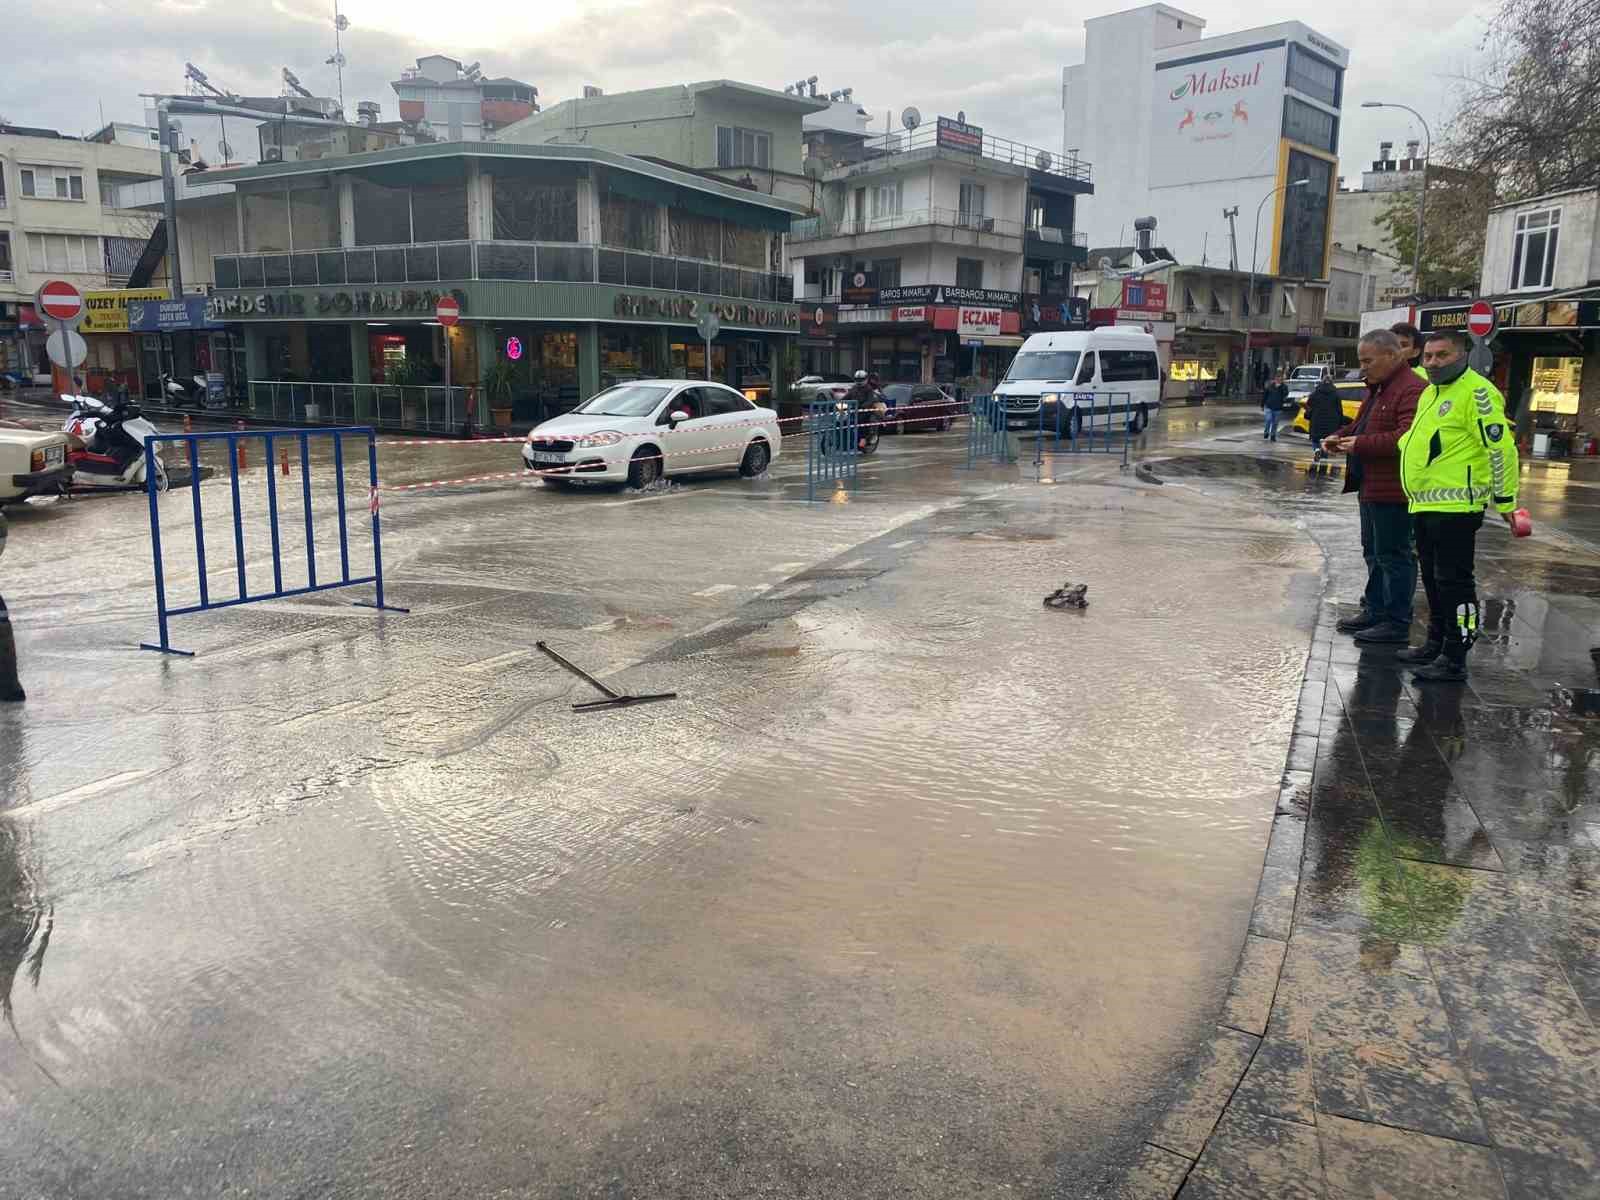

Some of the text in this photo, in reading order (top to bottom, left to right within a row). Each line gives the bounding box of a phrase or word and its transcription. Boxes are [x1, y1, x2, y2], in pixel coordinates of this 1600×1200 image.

[1177, 62, 1261, 97] Maksul
[945, 287, 985, 300] BARBAROS
[899, 309, 923, 318] ECZANE
[962, 310, 1001, 326] ECZANE
[1431, 312, 1468, 327] BARBARO
